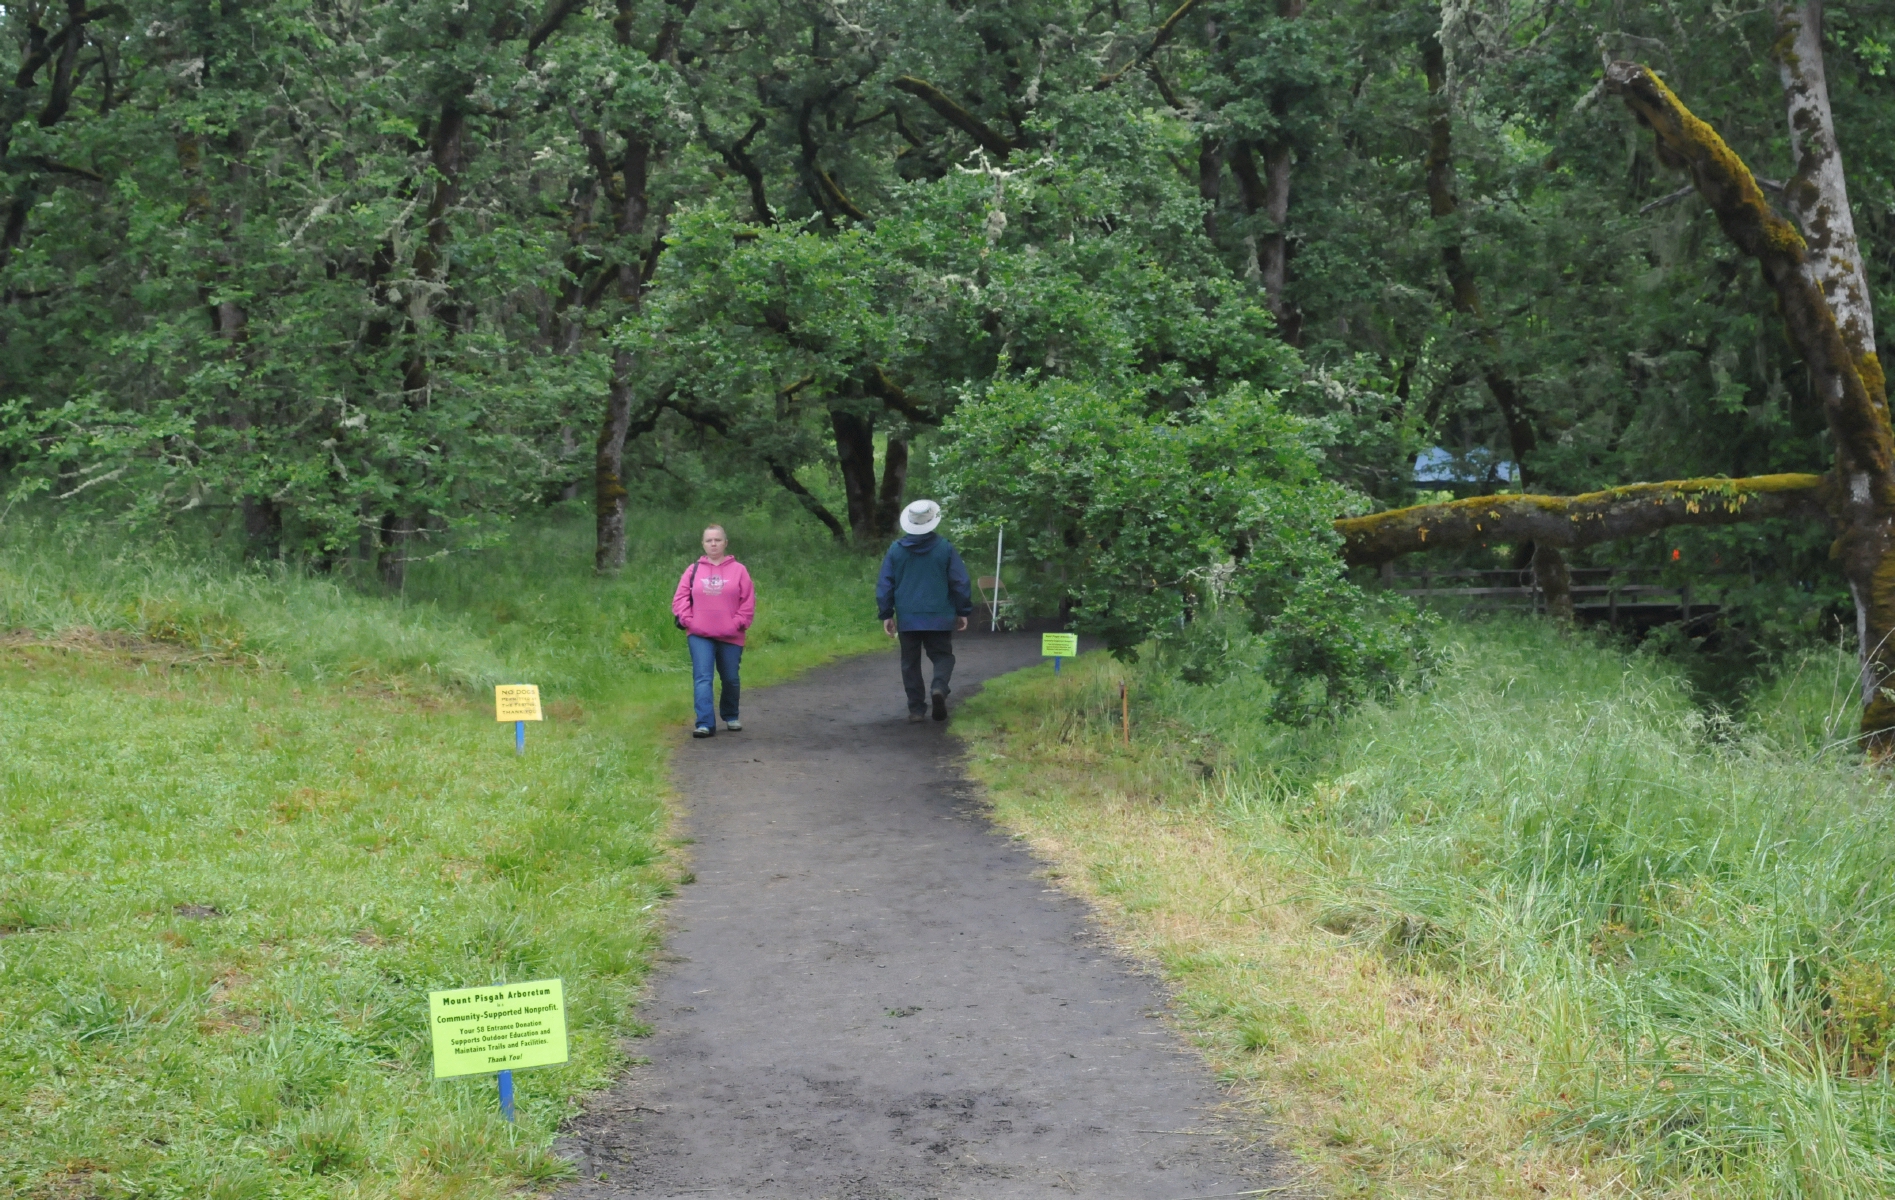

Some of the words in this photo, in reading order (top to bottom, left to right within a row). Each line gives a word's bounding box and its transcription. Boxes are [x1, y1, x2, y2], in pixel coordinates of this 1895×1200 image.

[443, 996, 471, 1006] Mount
[475, 992, 504, 1003] Pisgah
[508, 988, 550, 999] Arboretum
[437, 1007, 522, 1023] Community-Supported
[524, 1003, 558, 1014] Nonprofit.
[487, 1024, 514, 1032] Entrance
[515, 1020, 542, 1029] Donation
[451, 1037, 480, 1045] Supports
[482, 1034, 508, 1042] Outdoor
[510, 1030, 539, 1039] Education
[455, 1046, 486, 1054] Maintains
[488, 1043, 506, 1051] Trails
[520, 1038, 549, 1047] Facilities.
[488, 1056, 506, 1064] Thank
